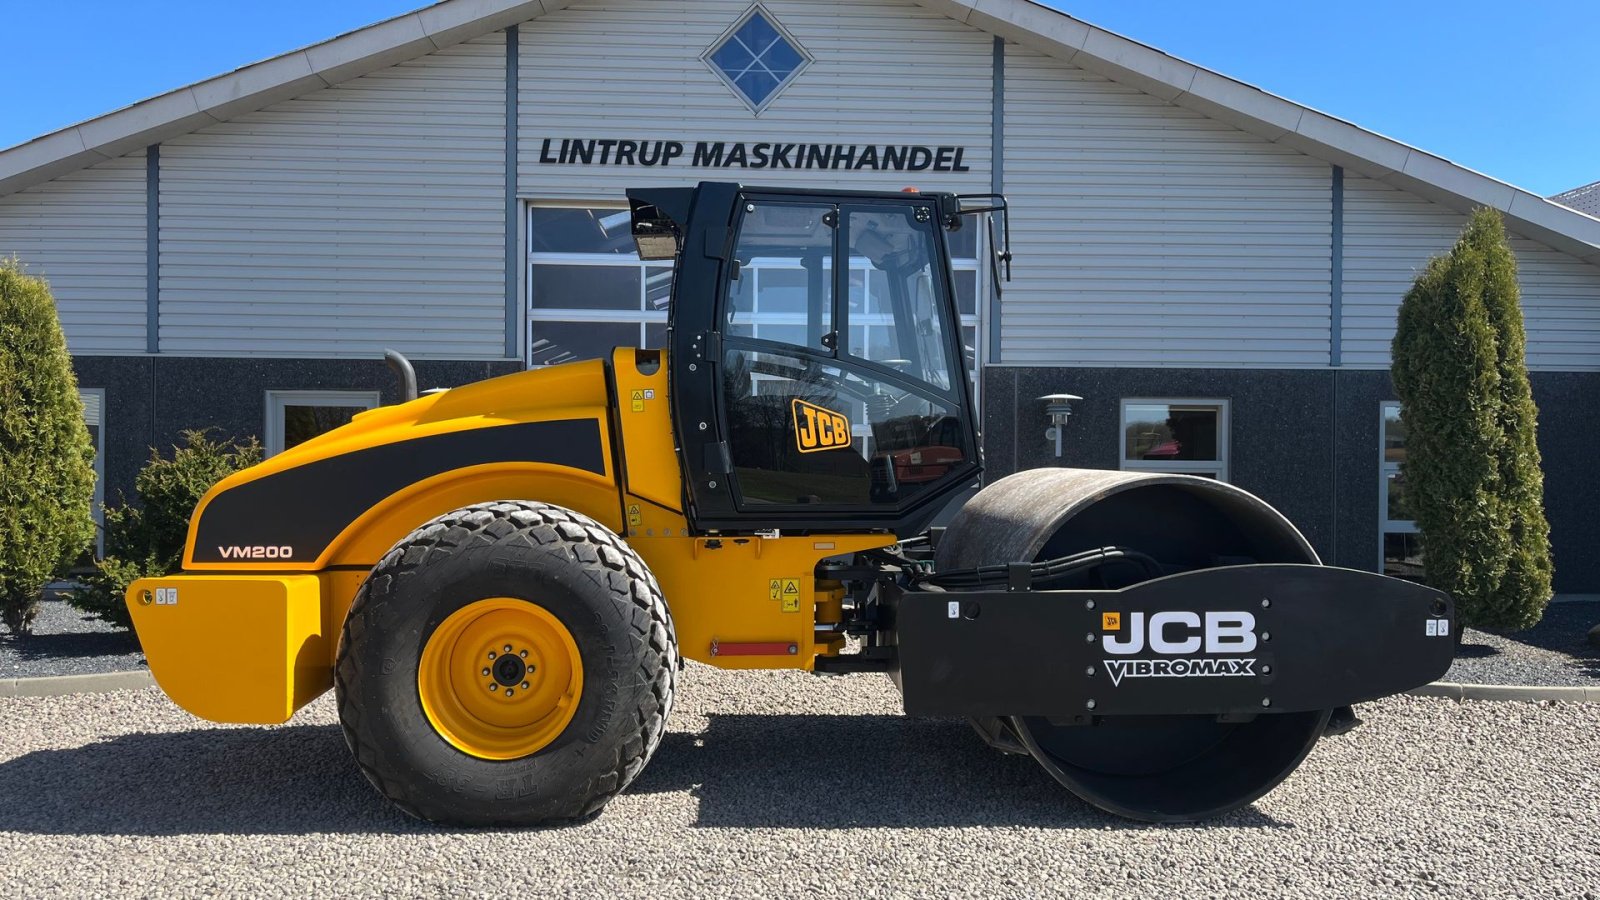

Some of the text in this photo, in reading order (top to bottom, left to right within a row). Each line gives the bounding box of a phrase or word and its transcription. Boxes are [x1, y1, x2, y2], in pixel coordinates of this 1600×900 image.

[539, 138, 970, 172] LINTRUP MASKINHANDEL
[800, 406, 847, 447] JCB
[218, 545, 293, 559] VM200
[1102, 611, 1257, 654] JCB
[1103, 658, 1257, 687] VIBROMAX
